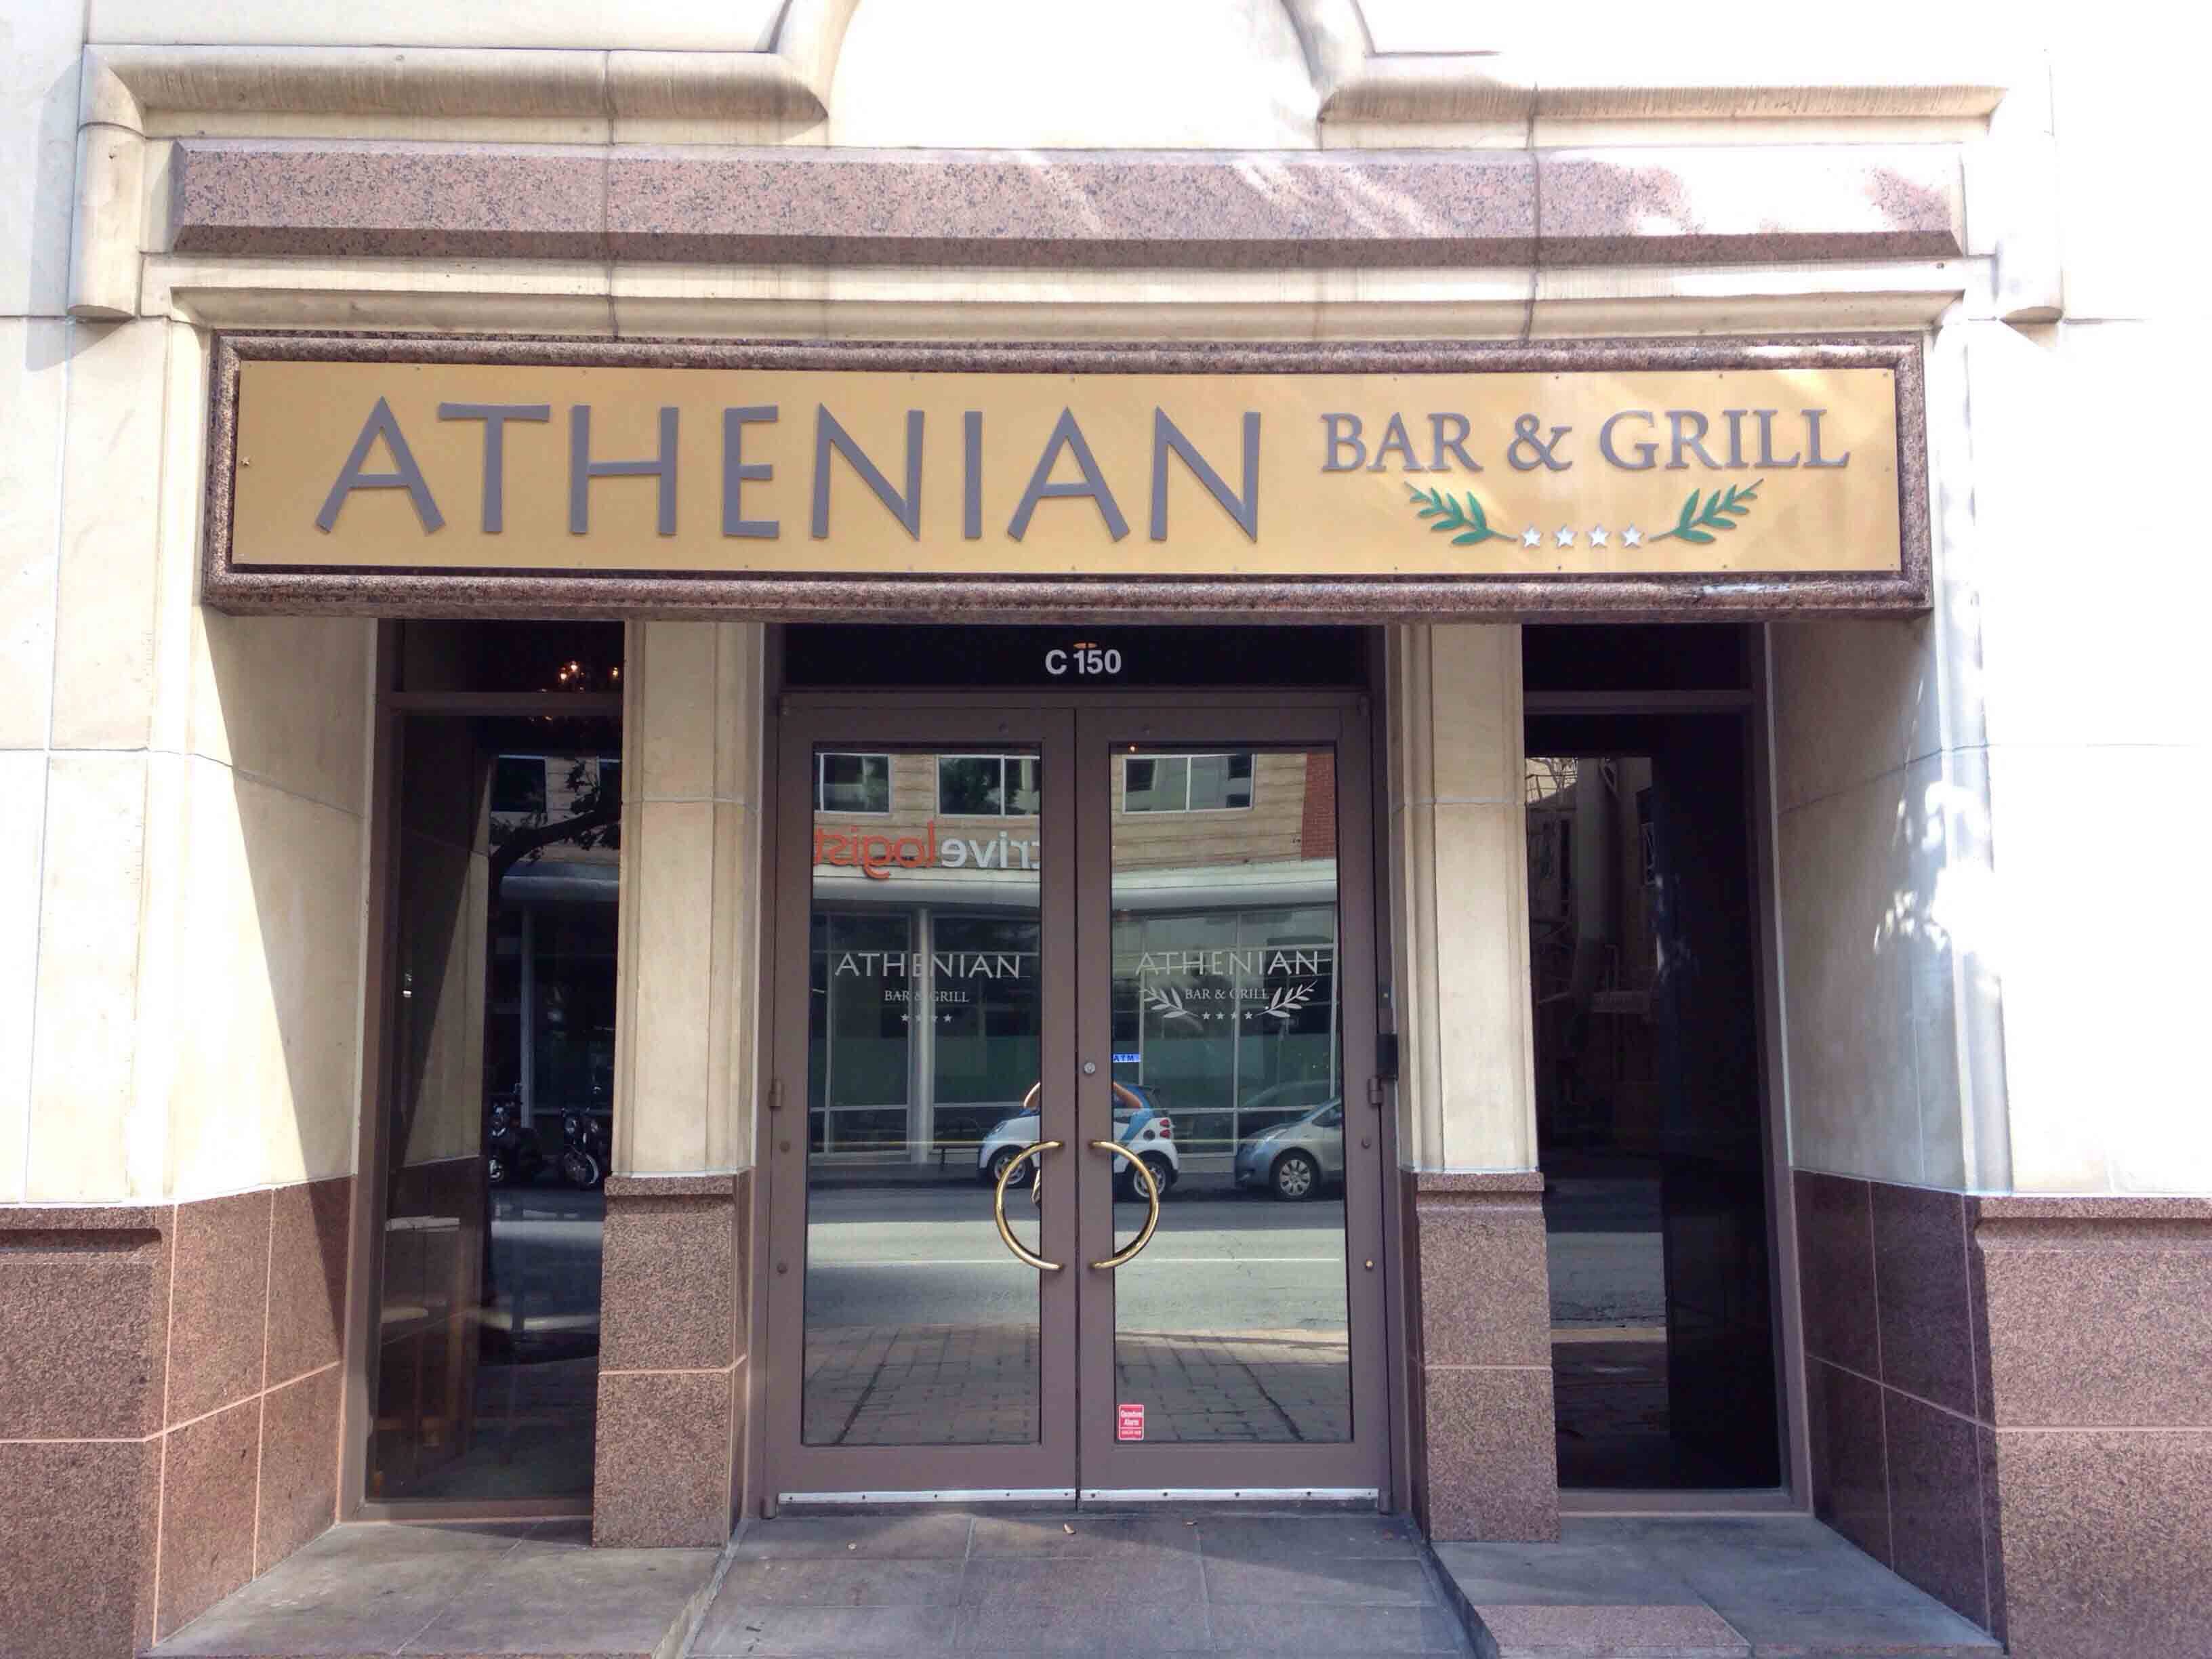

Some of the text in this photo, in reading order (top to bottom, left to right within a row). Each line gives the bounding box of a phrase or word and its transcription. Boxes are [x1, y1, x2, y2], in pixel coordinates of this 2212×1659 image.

[314, 395, 1851, 543] ATHENIAN BAR & GRILL
[1045, 649, 1122, 675] C 150
[834, 951, 1021, 979] ATHENIAN
[1134, 950, 1318, 976] ATHENIAN
[884, 989, 910, 1002] BAR
[929, 990, 970, 1003] GRILL
[1185, 987, 1269, 1000] BAR & GRILL
